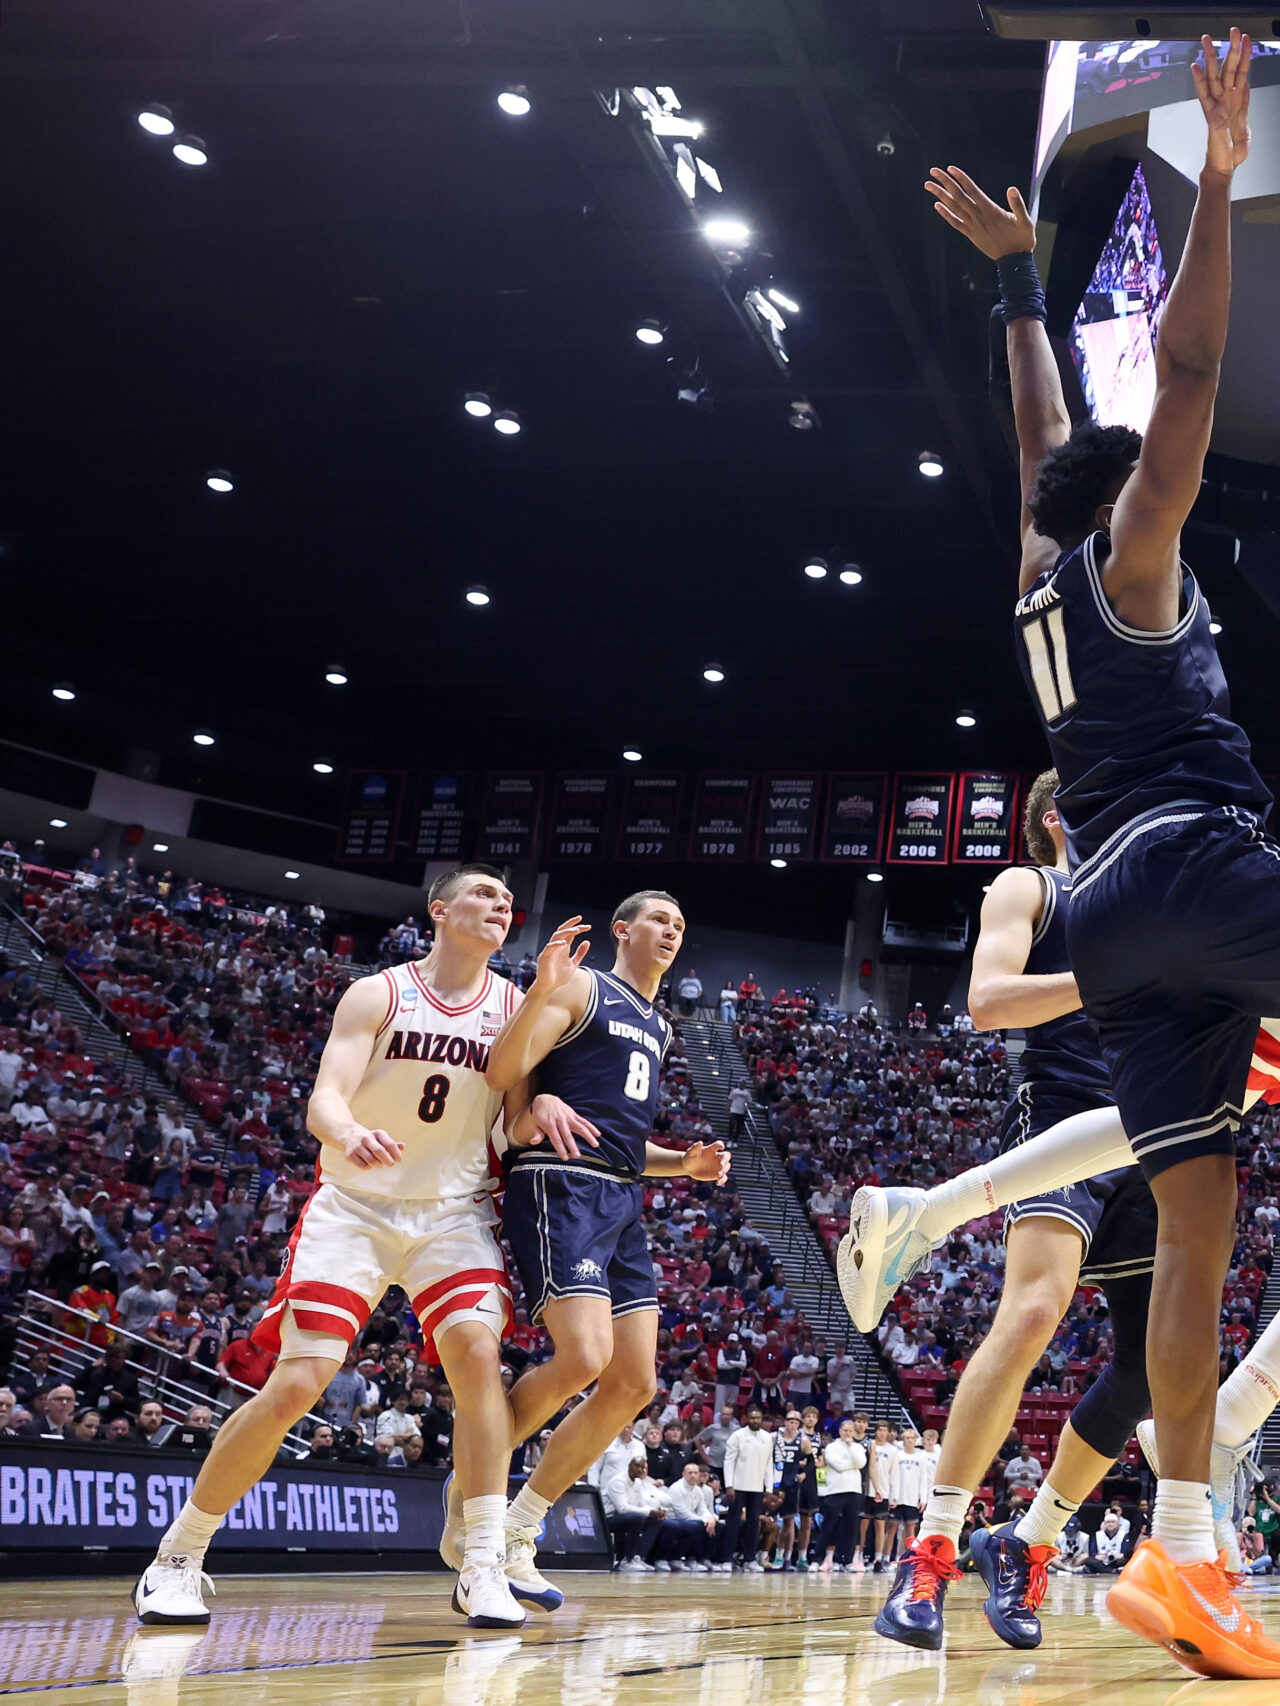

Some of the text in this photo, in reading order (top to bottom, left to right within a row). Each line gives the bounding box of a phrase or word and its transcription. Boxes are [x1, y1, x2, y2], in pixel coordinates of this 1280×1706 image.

[1021, 605, 1078, 723] 11
[769, 798, 812, 809] WAC
[834, 844, 868, 856] 2002
[900, 844, 936, 857] 2006
[966, 844, 1000, 857] 2006
[608, 1020, 642, 1045] UTAH
[623, 1050, 651, 1101] 8
[418, 1074, 450, 1123] 8
[1, 1466, 399, 1533] BRATES STENT-ATHLETES
